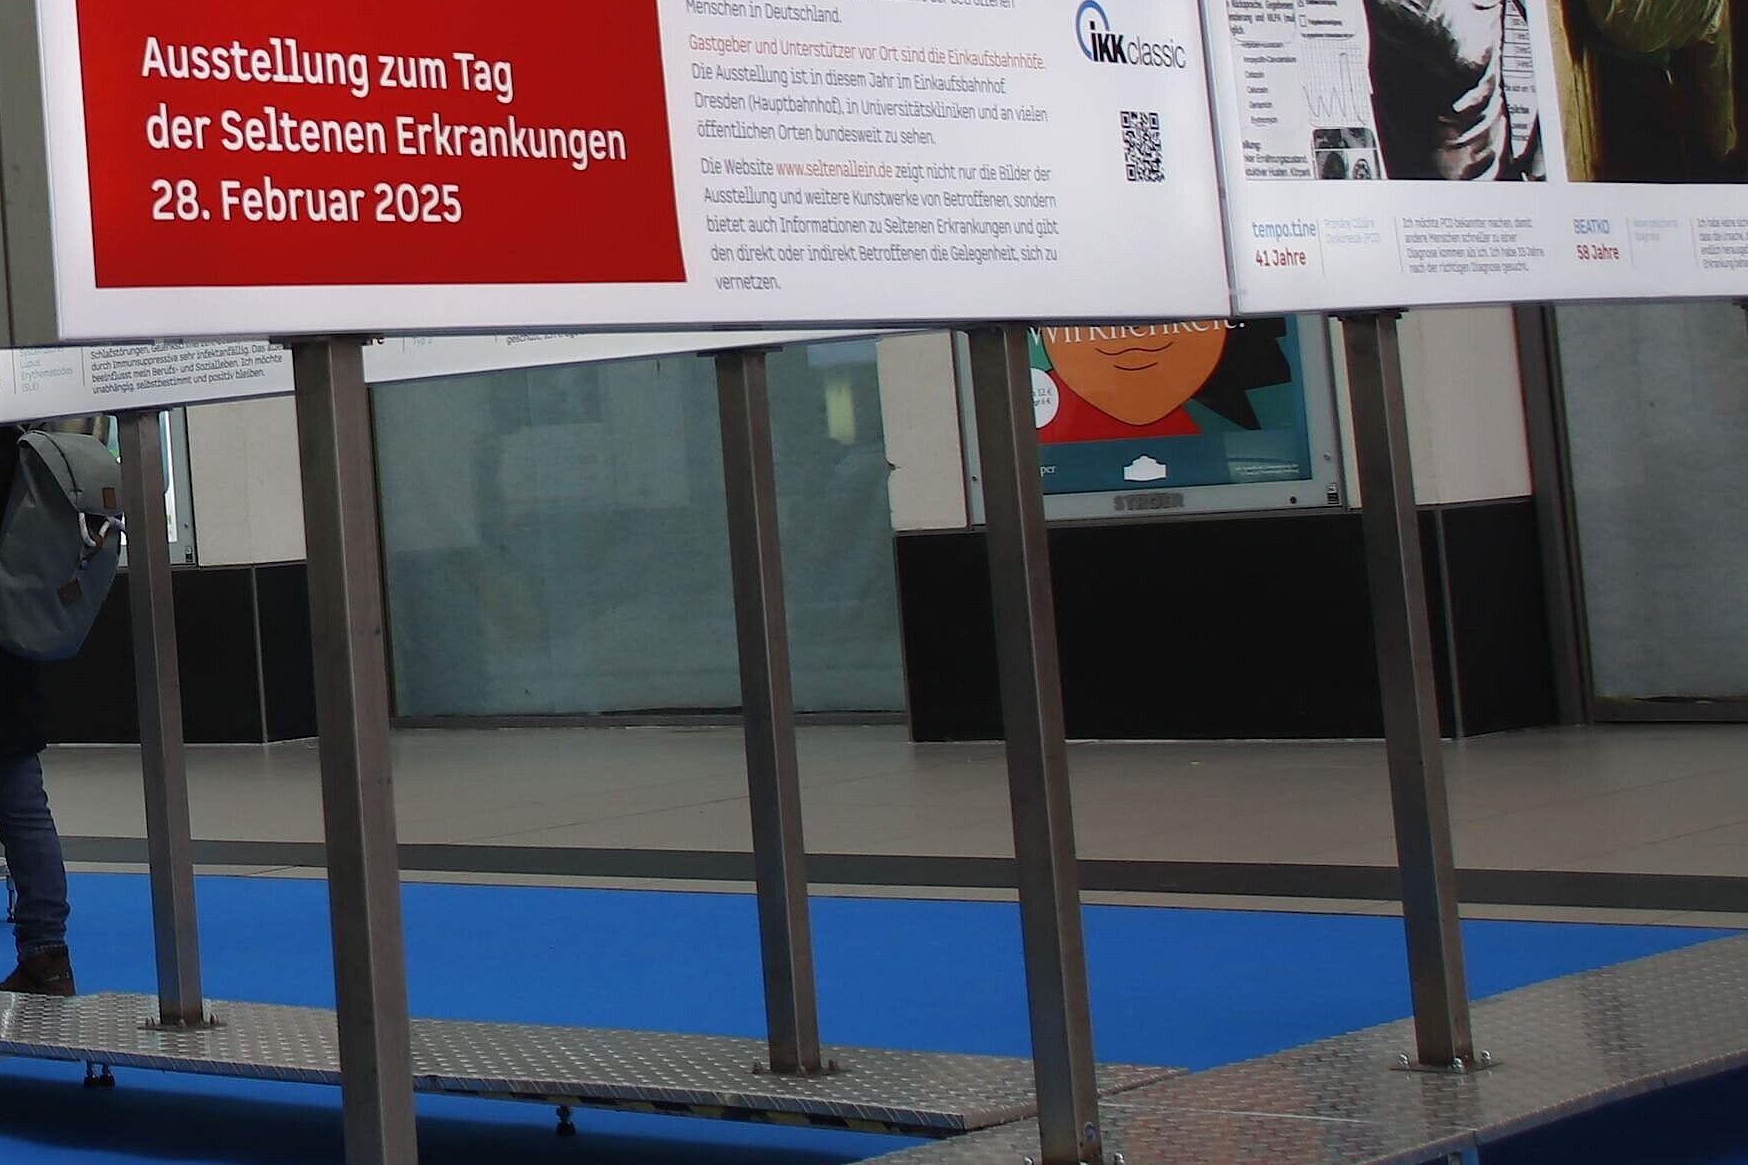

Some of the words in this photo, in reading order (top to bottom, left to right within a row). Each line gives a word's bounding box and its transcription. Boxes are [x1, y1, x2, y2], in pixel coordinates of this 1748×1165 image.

[1127, 37, 1186, 68] classic
[142, 36, 368, 97] Ausstellung
[378, 55, 447, 89] zum
[453, 52, 512, 103] Tag
[146, 102, 210, 149] der
[221, 106, 386, 153] Seltenen
[396, 113, 626, 170] Erkrankungen
[700, 156, 722, 174] Die
[723, 157, 773, 175] Website
[776, 159, 892, 178] www.seltenallein.de
[894, 162, 925, 182] zeigt
[926, 162, 956, 179] nicht
[958, 167, 976, 180] nur
[979, 163, 996, 180] die
[999, 164, 1031, 181] Bilder
[1033, 166, 1051, 181] der
[151, 179, 209, 220] 28.
[221, 177, 364, 221] Februar
[374, 182, 461, 222] 2025
[1256, 249, 1270, 267] 41
[1272, 249, 1307, 266] Jahre
[1577, 244, 1590, 260] 58
[1592, 244, 1620, 260] Jahre
